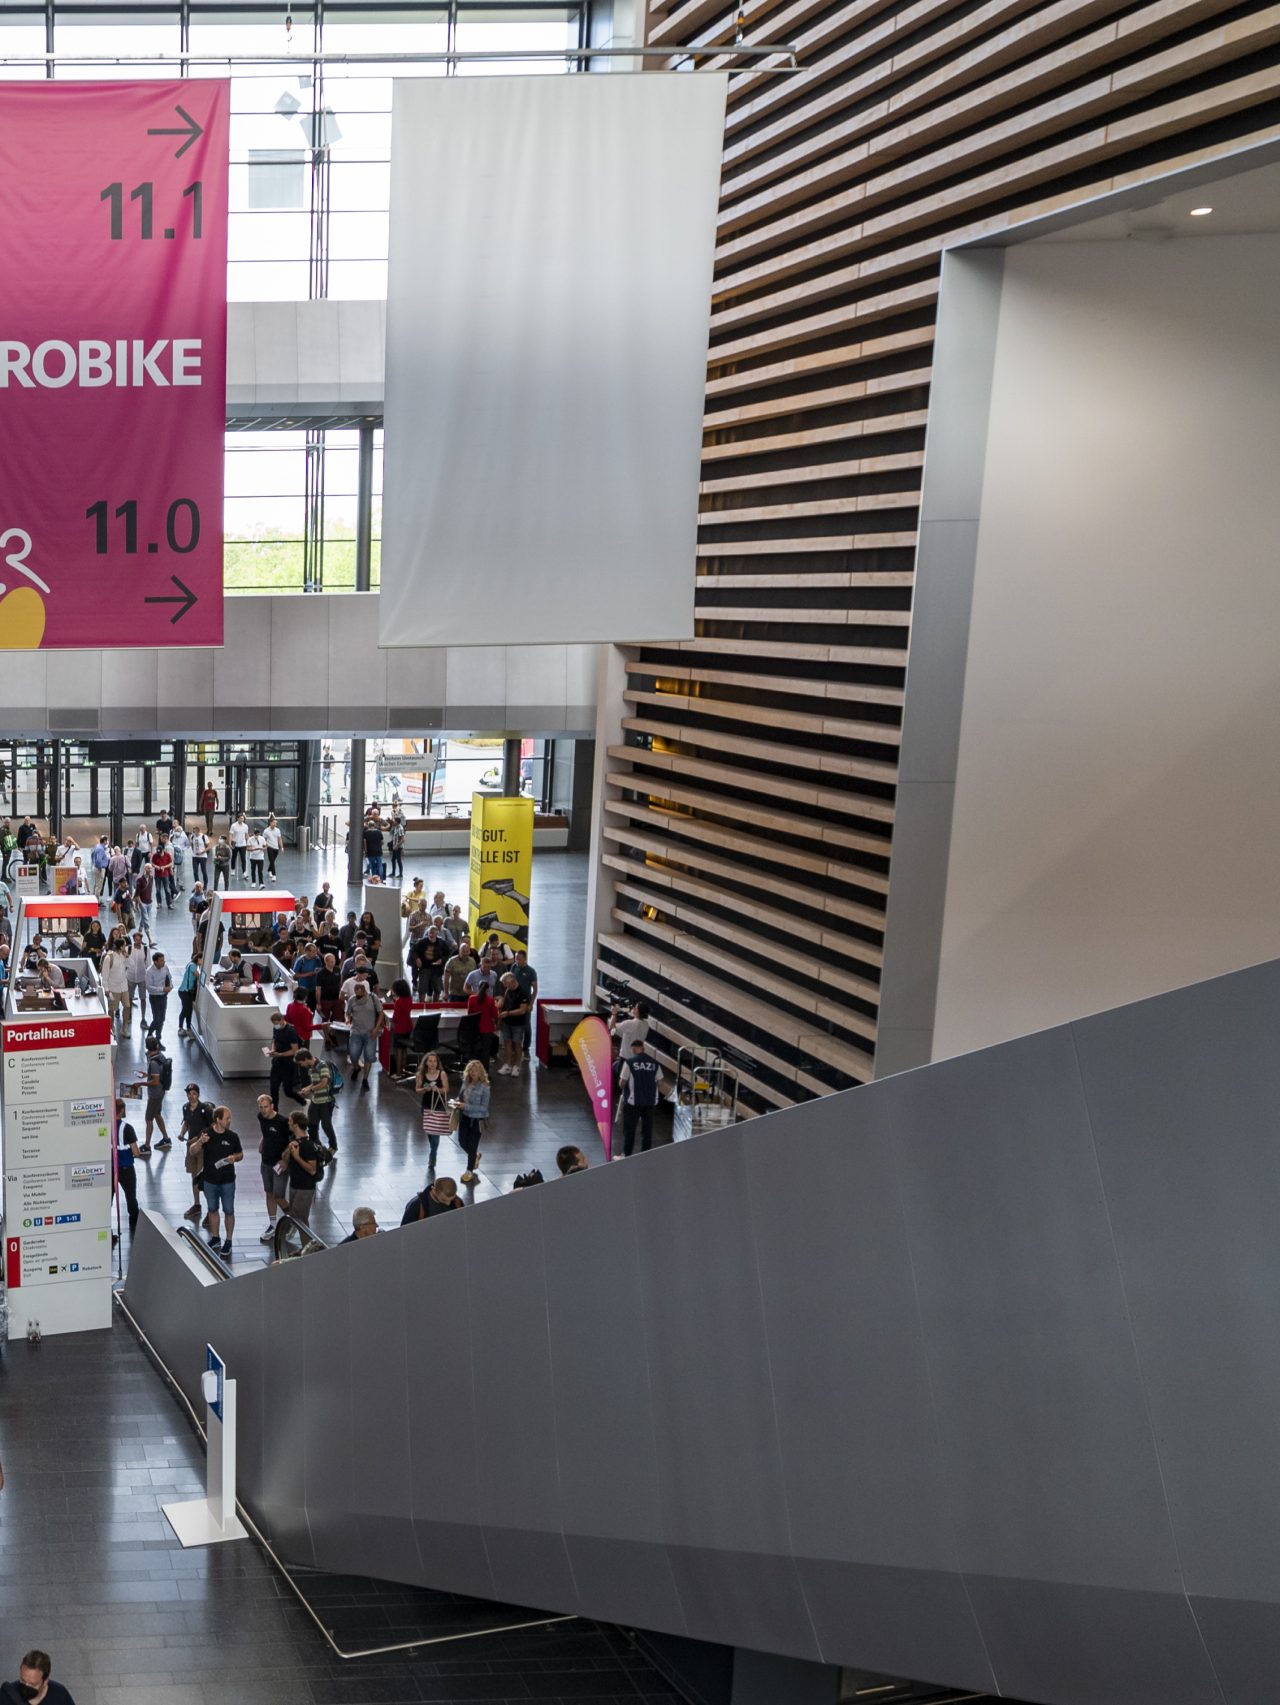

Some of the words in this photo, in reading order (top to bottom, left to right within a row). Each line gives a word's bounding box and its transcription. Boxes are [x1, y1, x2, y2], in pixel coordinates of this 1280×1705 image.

[100, 181, 204, 241] 11.1
[86, 497, 201, 555] 11.0
[482, 829, 507, 842] GUT.
[502, 850, 520, 863] IST
[7, 1027, 75, 1042] Portalhaus
[8, 1058, 16, 1068] C
[12, 1110, 18, 1120] 1
[73, 1167, 103, 1175] ACADEMY
[10, 1242, 17, 1252] 0
